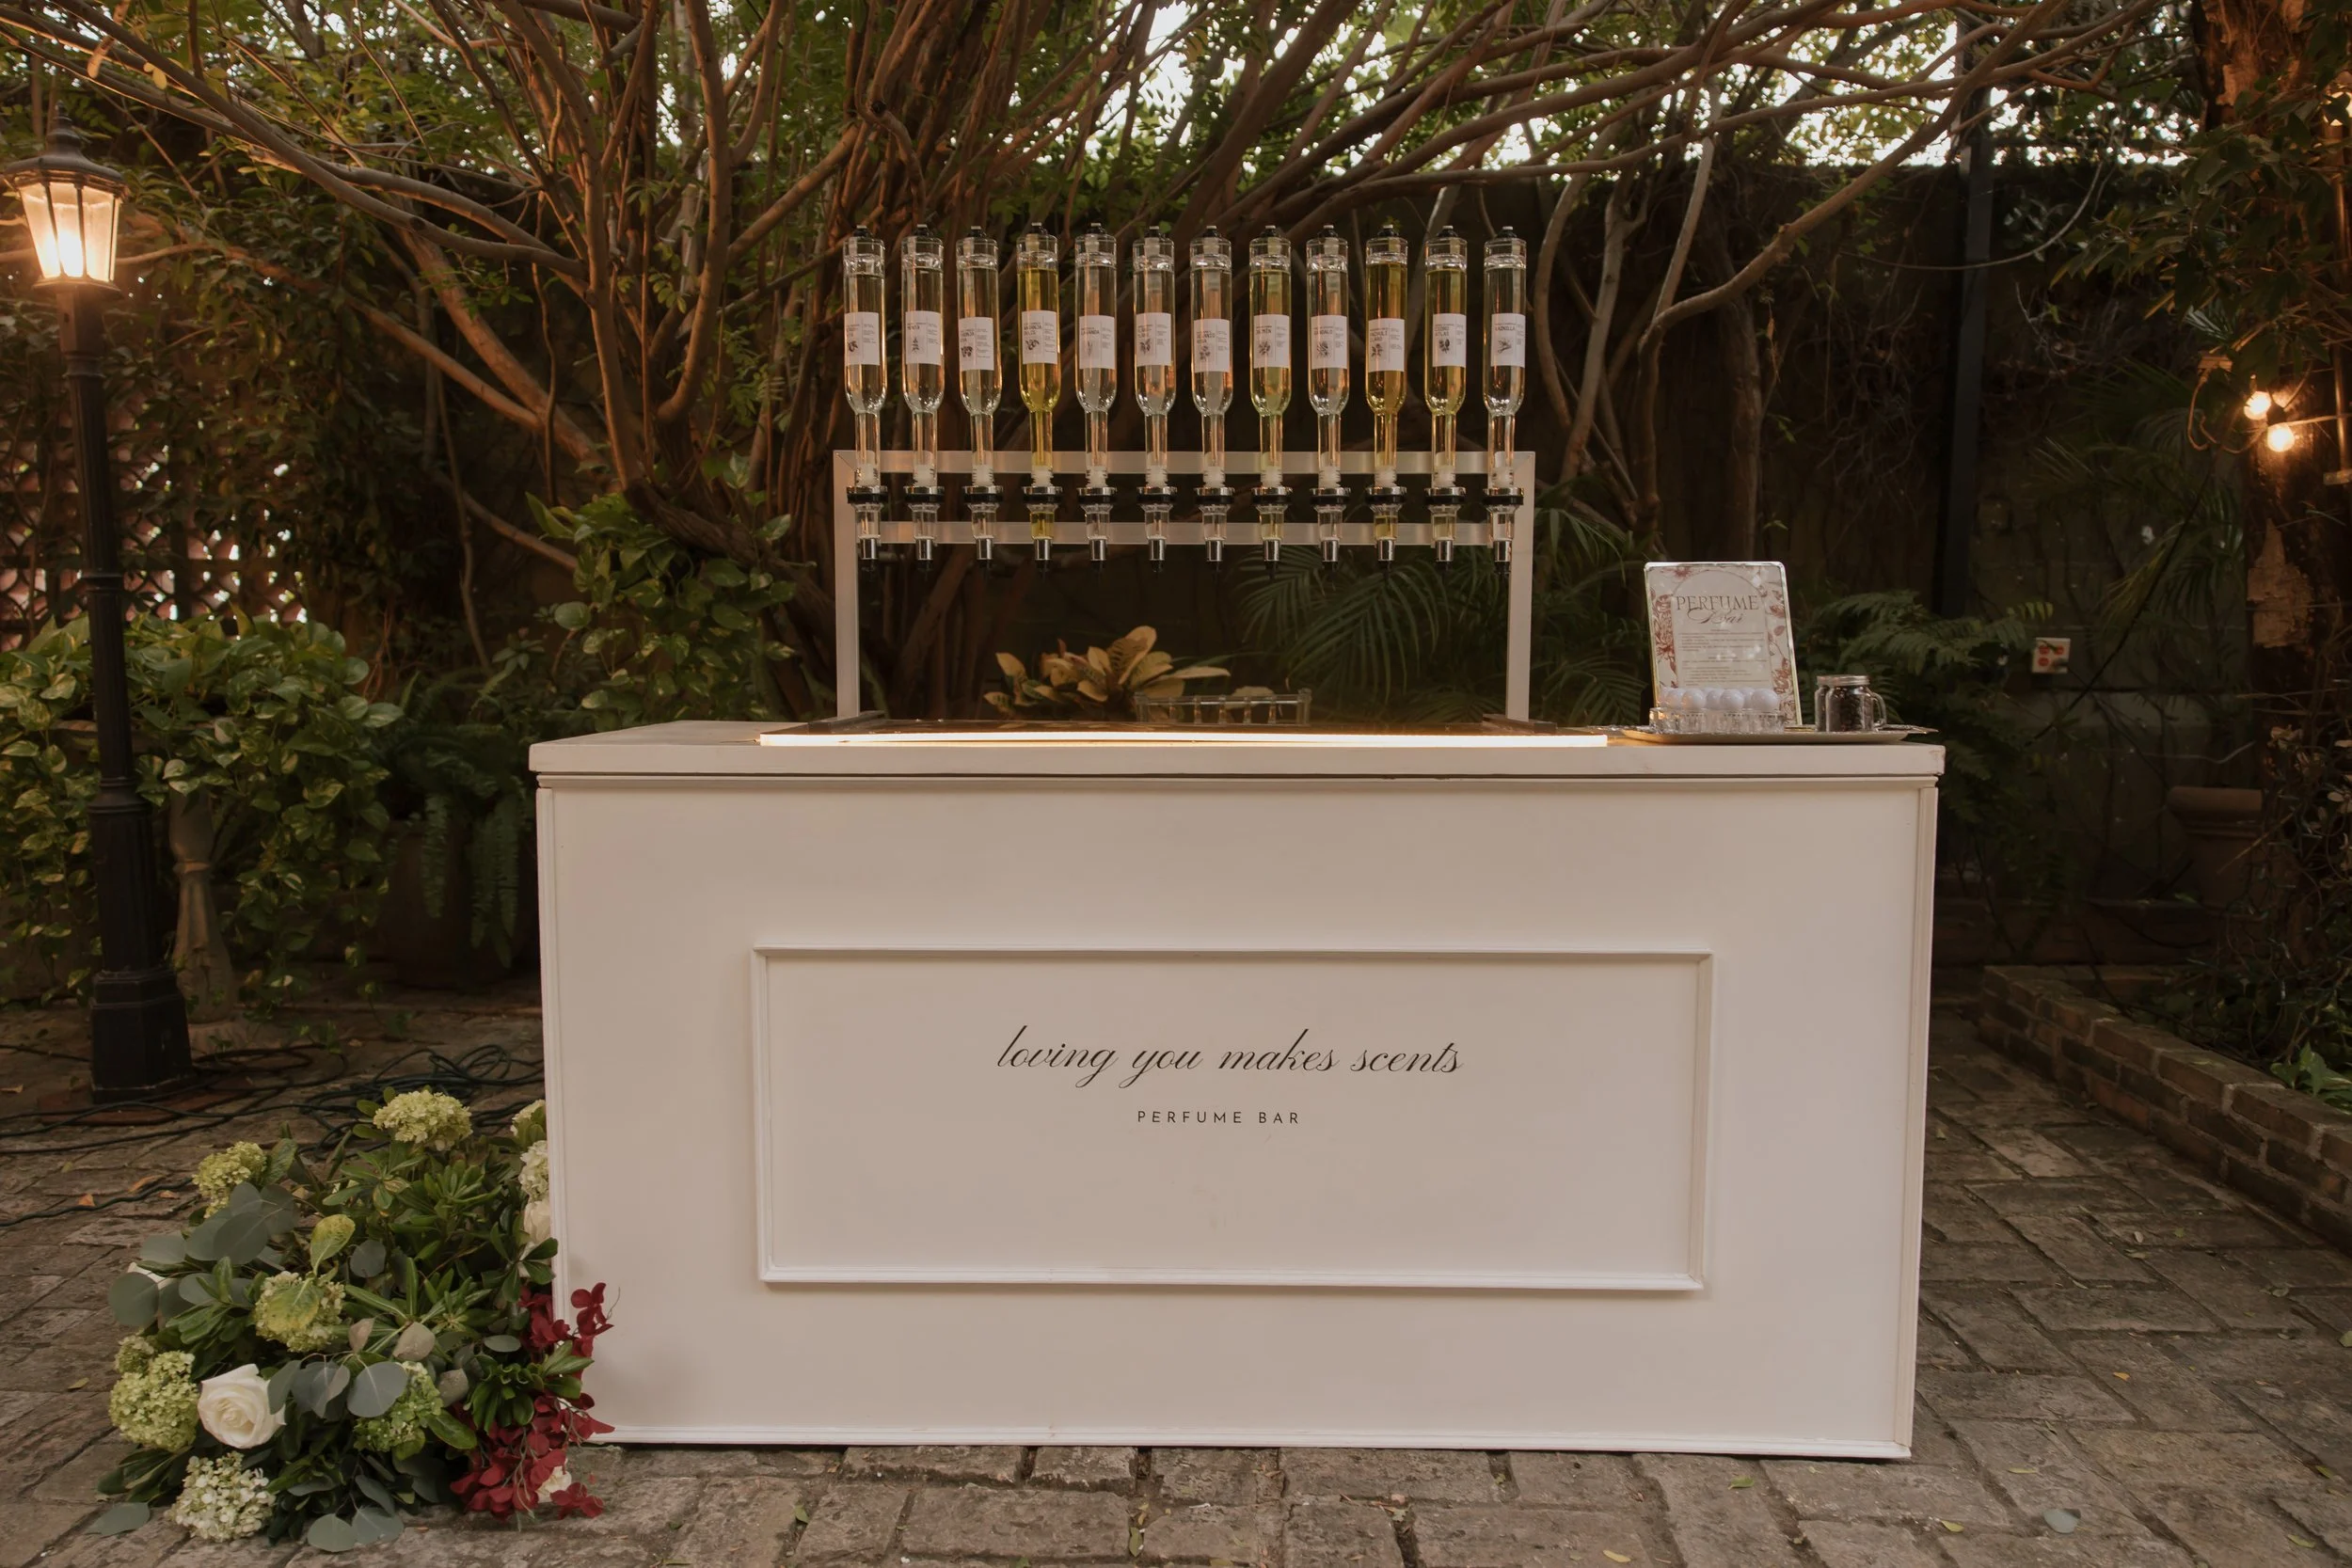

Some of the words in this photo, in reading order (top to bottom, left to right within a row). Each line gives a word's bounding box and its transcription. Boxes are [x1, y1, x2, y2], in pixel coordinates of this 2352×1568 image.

[1676, 594, 1760, 610] PERFUME
[997, 1024, 1119, 1088] loving
[1119, 1050, 1203, 1088] you
[1217, 1028, 1340, 1071] makes
[1350, 1042, 1465, 1073] scents
[1137, 1111, 1242, 1124] PERFUME
[1259, 1112, 1298, 1124] BAR
